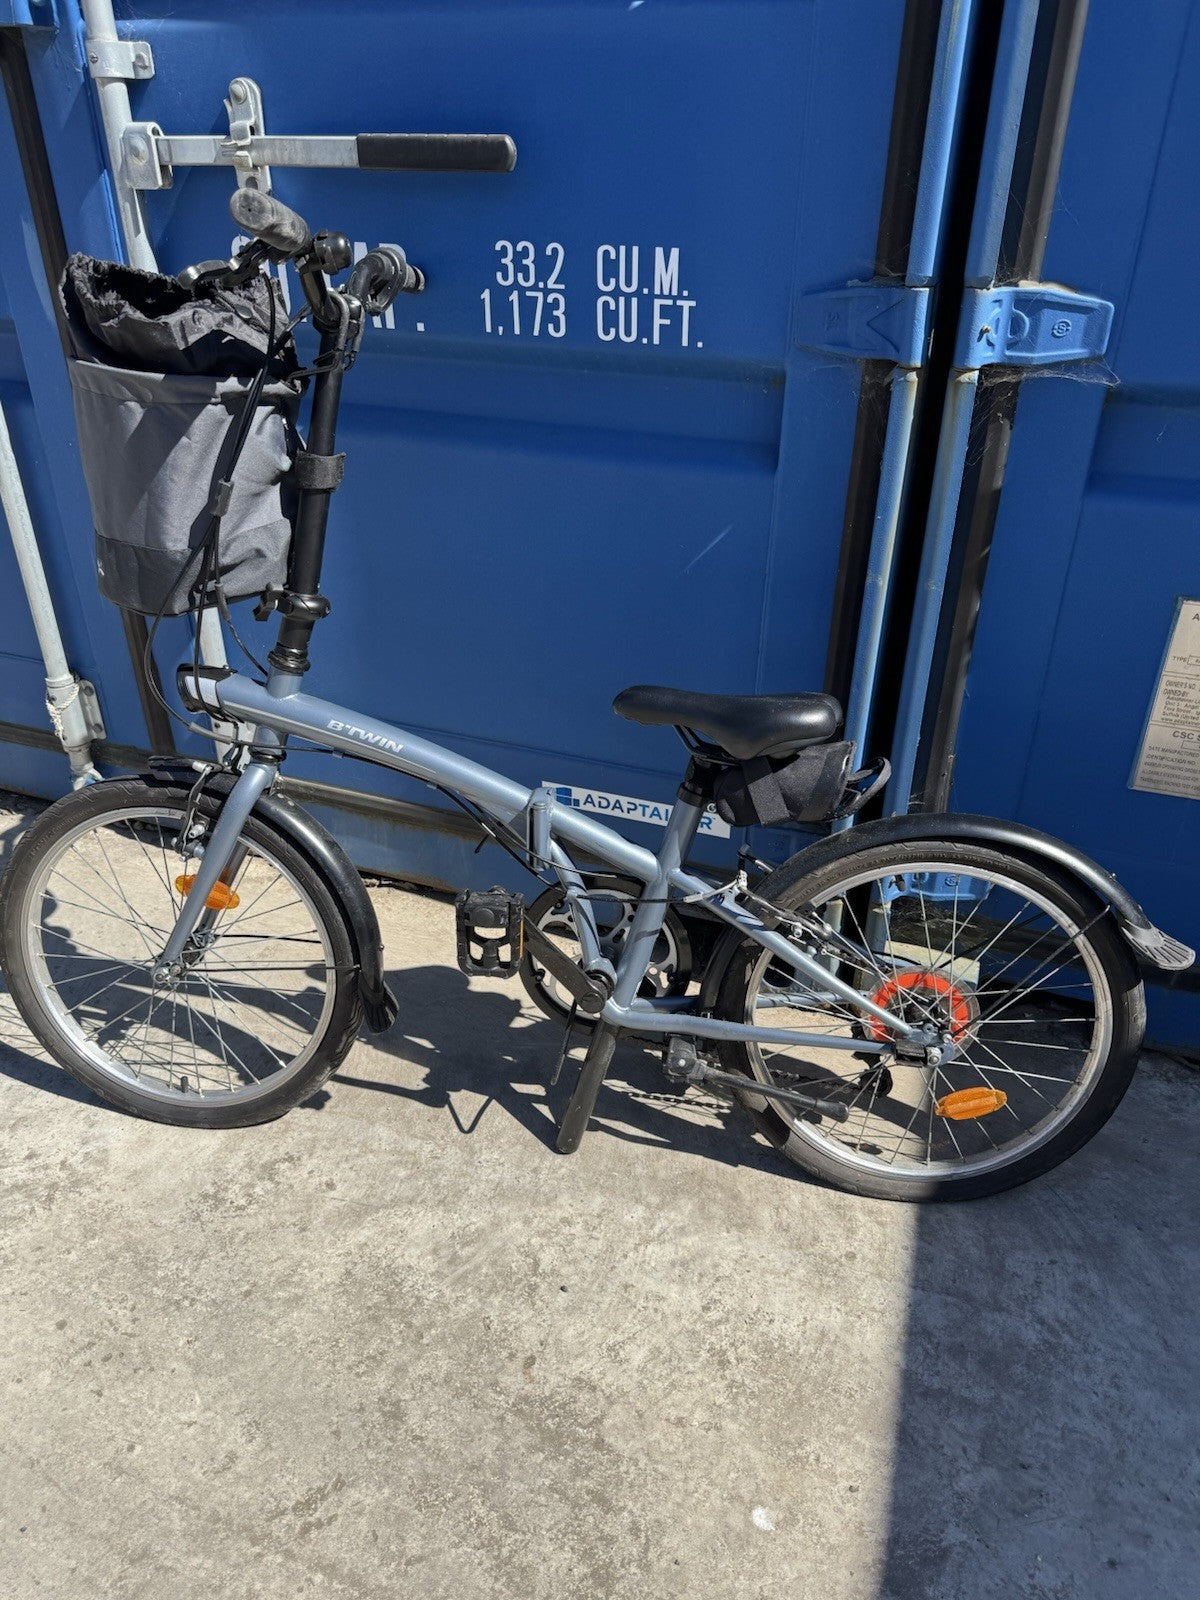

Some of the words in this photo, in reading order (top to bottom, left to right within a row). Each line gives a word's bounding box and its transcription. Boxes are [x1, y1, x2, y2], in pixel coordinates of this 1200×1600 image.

[495, 240, 566, 290] 33.2
[596, 244, 689, 297] CU.M.
[480, 288, 567, 338] 1,173
[596, 296, 703, 348] CU.FT.
[1172, 730, 1194, 740] CSC
[583, 793, 712, 830] ADAPTAIR
